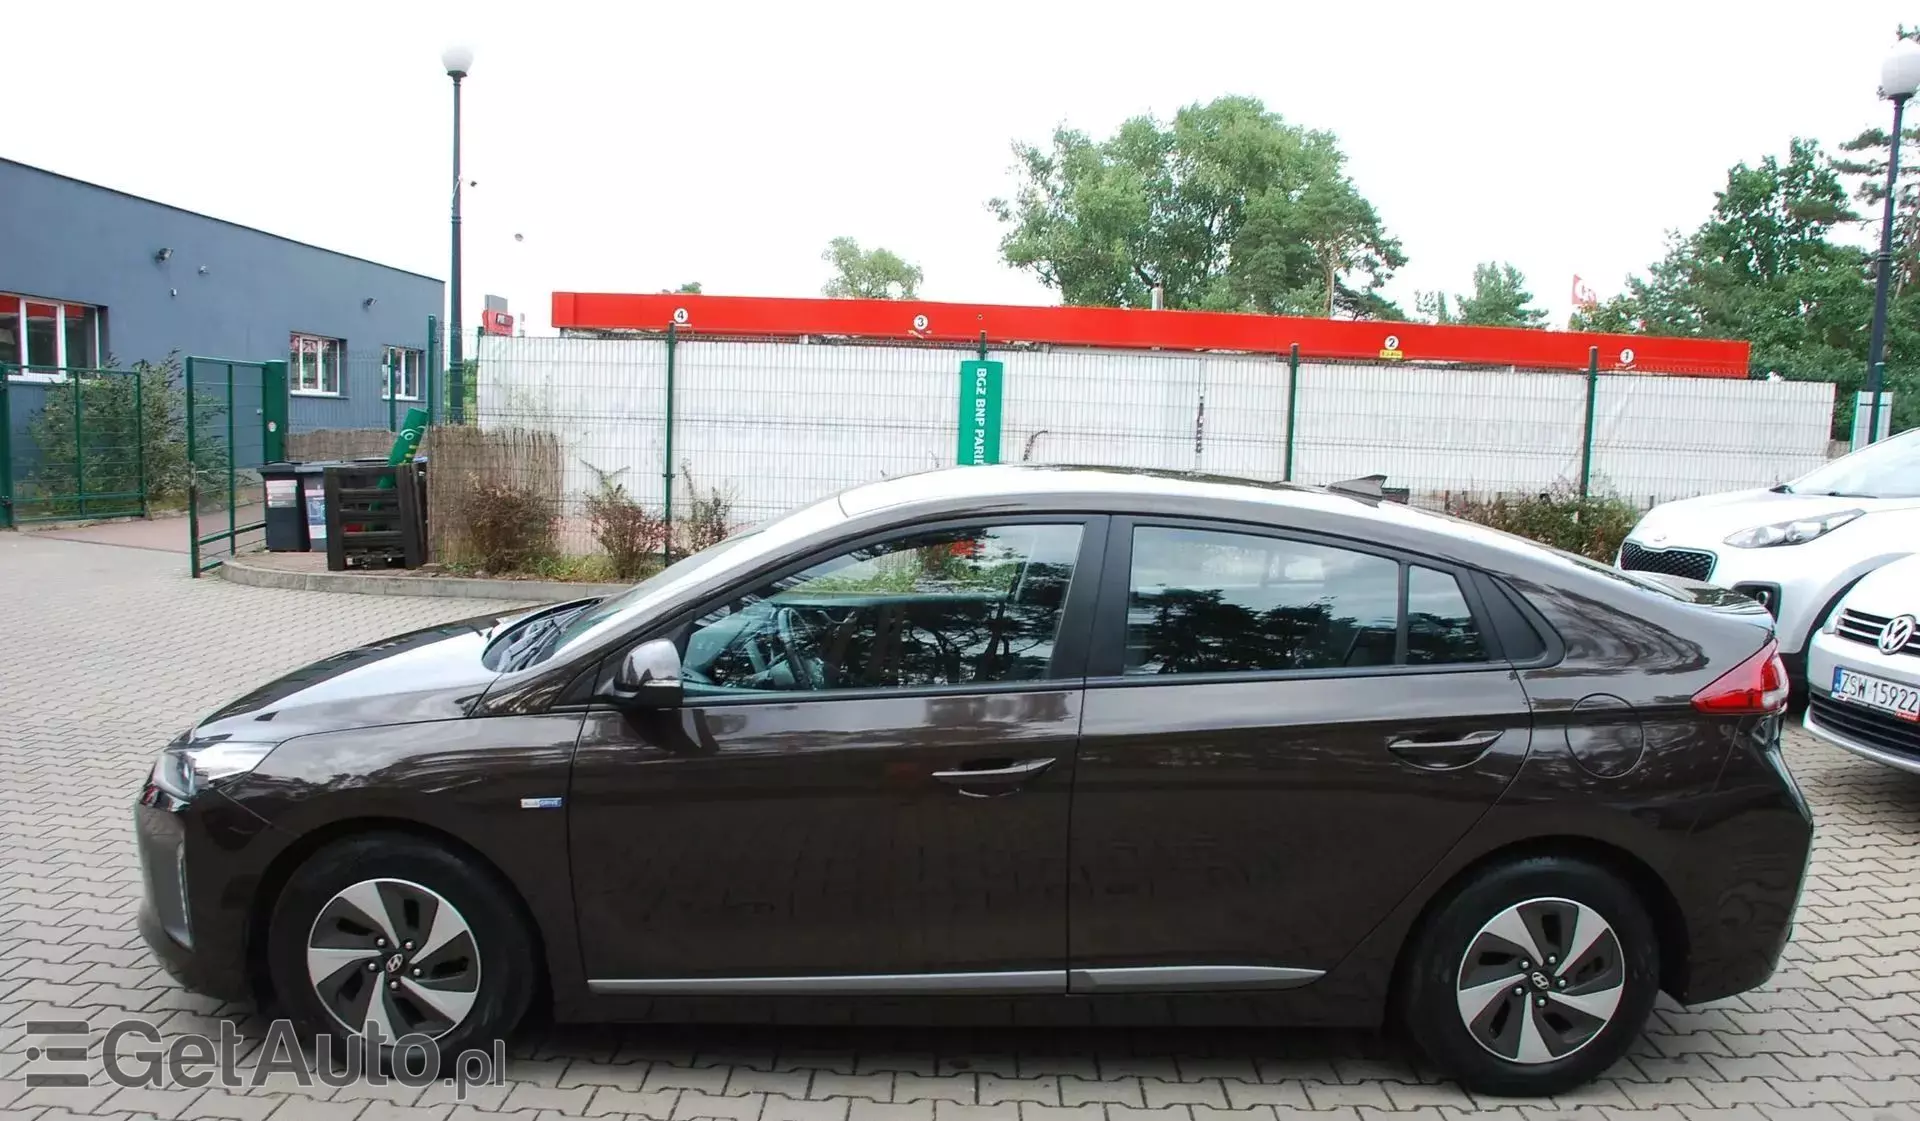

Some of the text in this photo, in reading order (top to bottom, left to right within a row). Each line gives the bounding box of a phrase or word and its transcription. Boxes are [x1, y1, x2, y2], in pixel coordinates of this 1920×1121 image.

[974, 398, 986, 427] BNP
[1840, 672, 1918, 713] ZSW 15922
